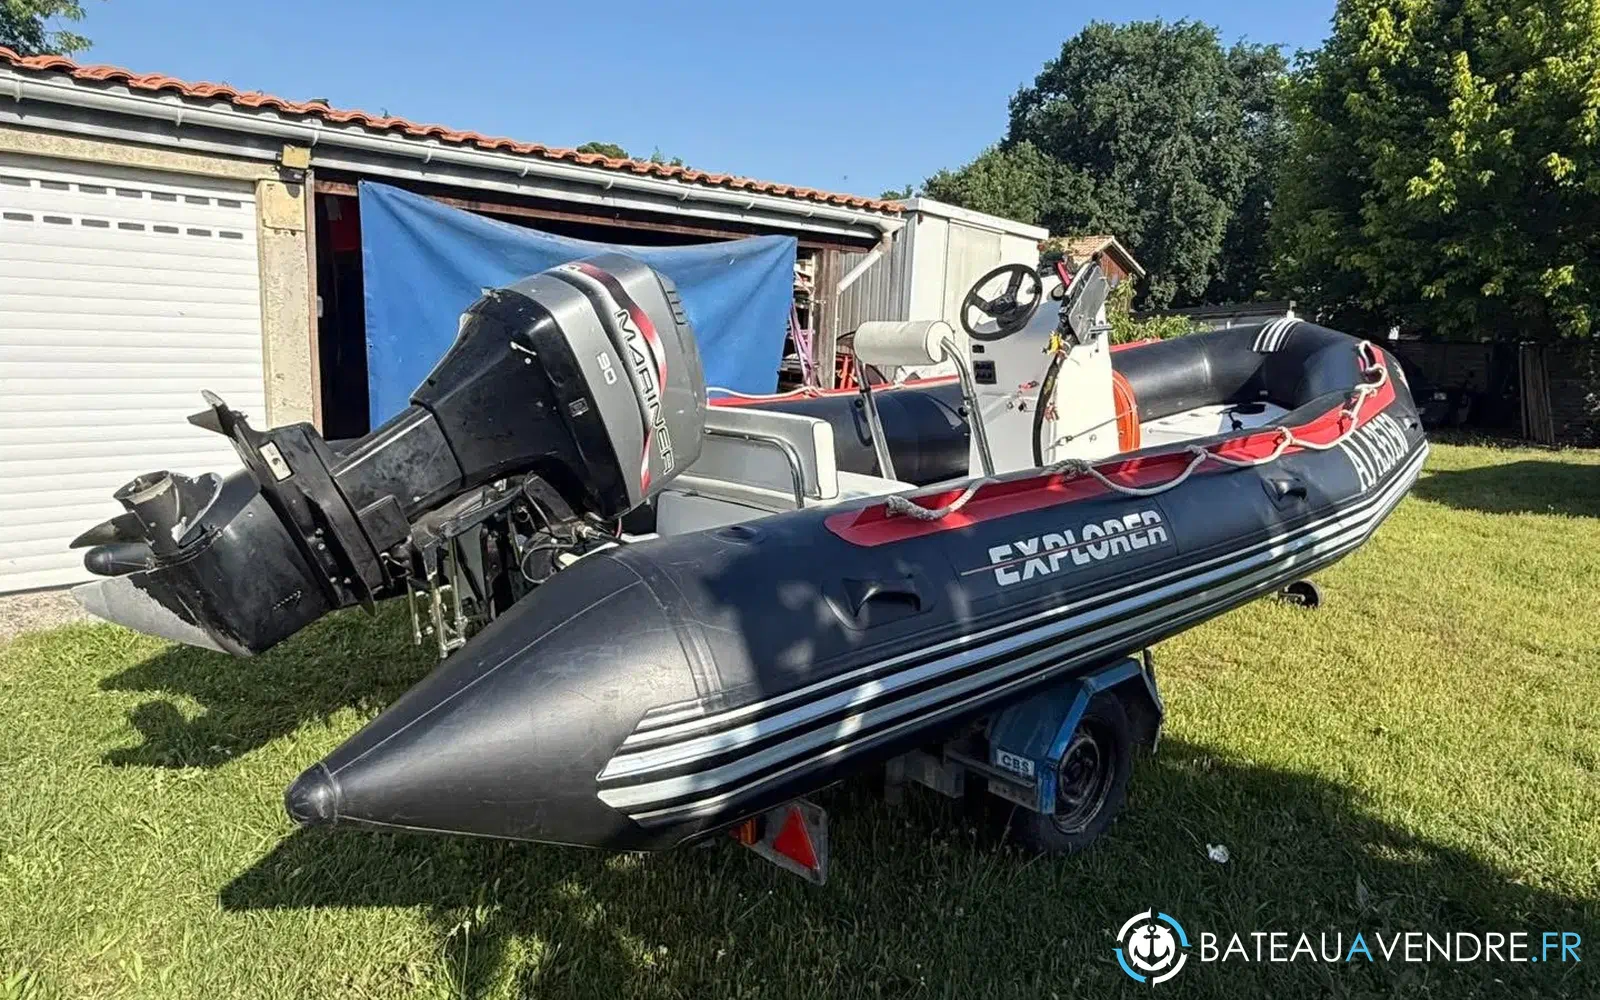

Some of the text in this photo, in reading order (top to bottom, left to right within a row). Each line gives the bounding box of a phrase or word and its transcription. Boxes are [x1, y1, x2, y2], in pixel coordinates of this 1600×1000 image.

[597, 352, 617, 385] 90
[615, 309, 674, 476] MARINER
[988, 510, 1168, 586] EXPLORER
[1003, 755, 1029, 772] CBS
